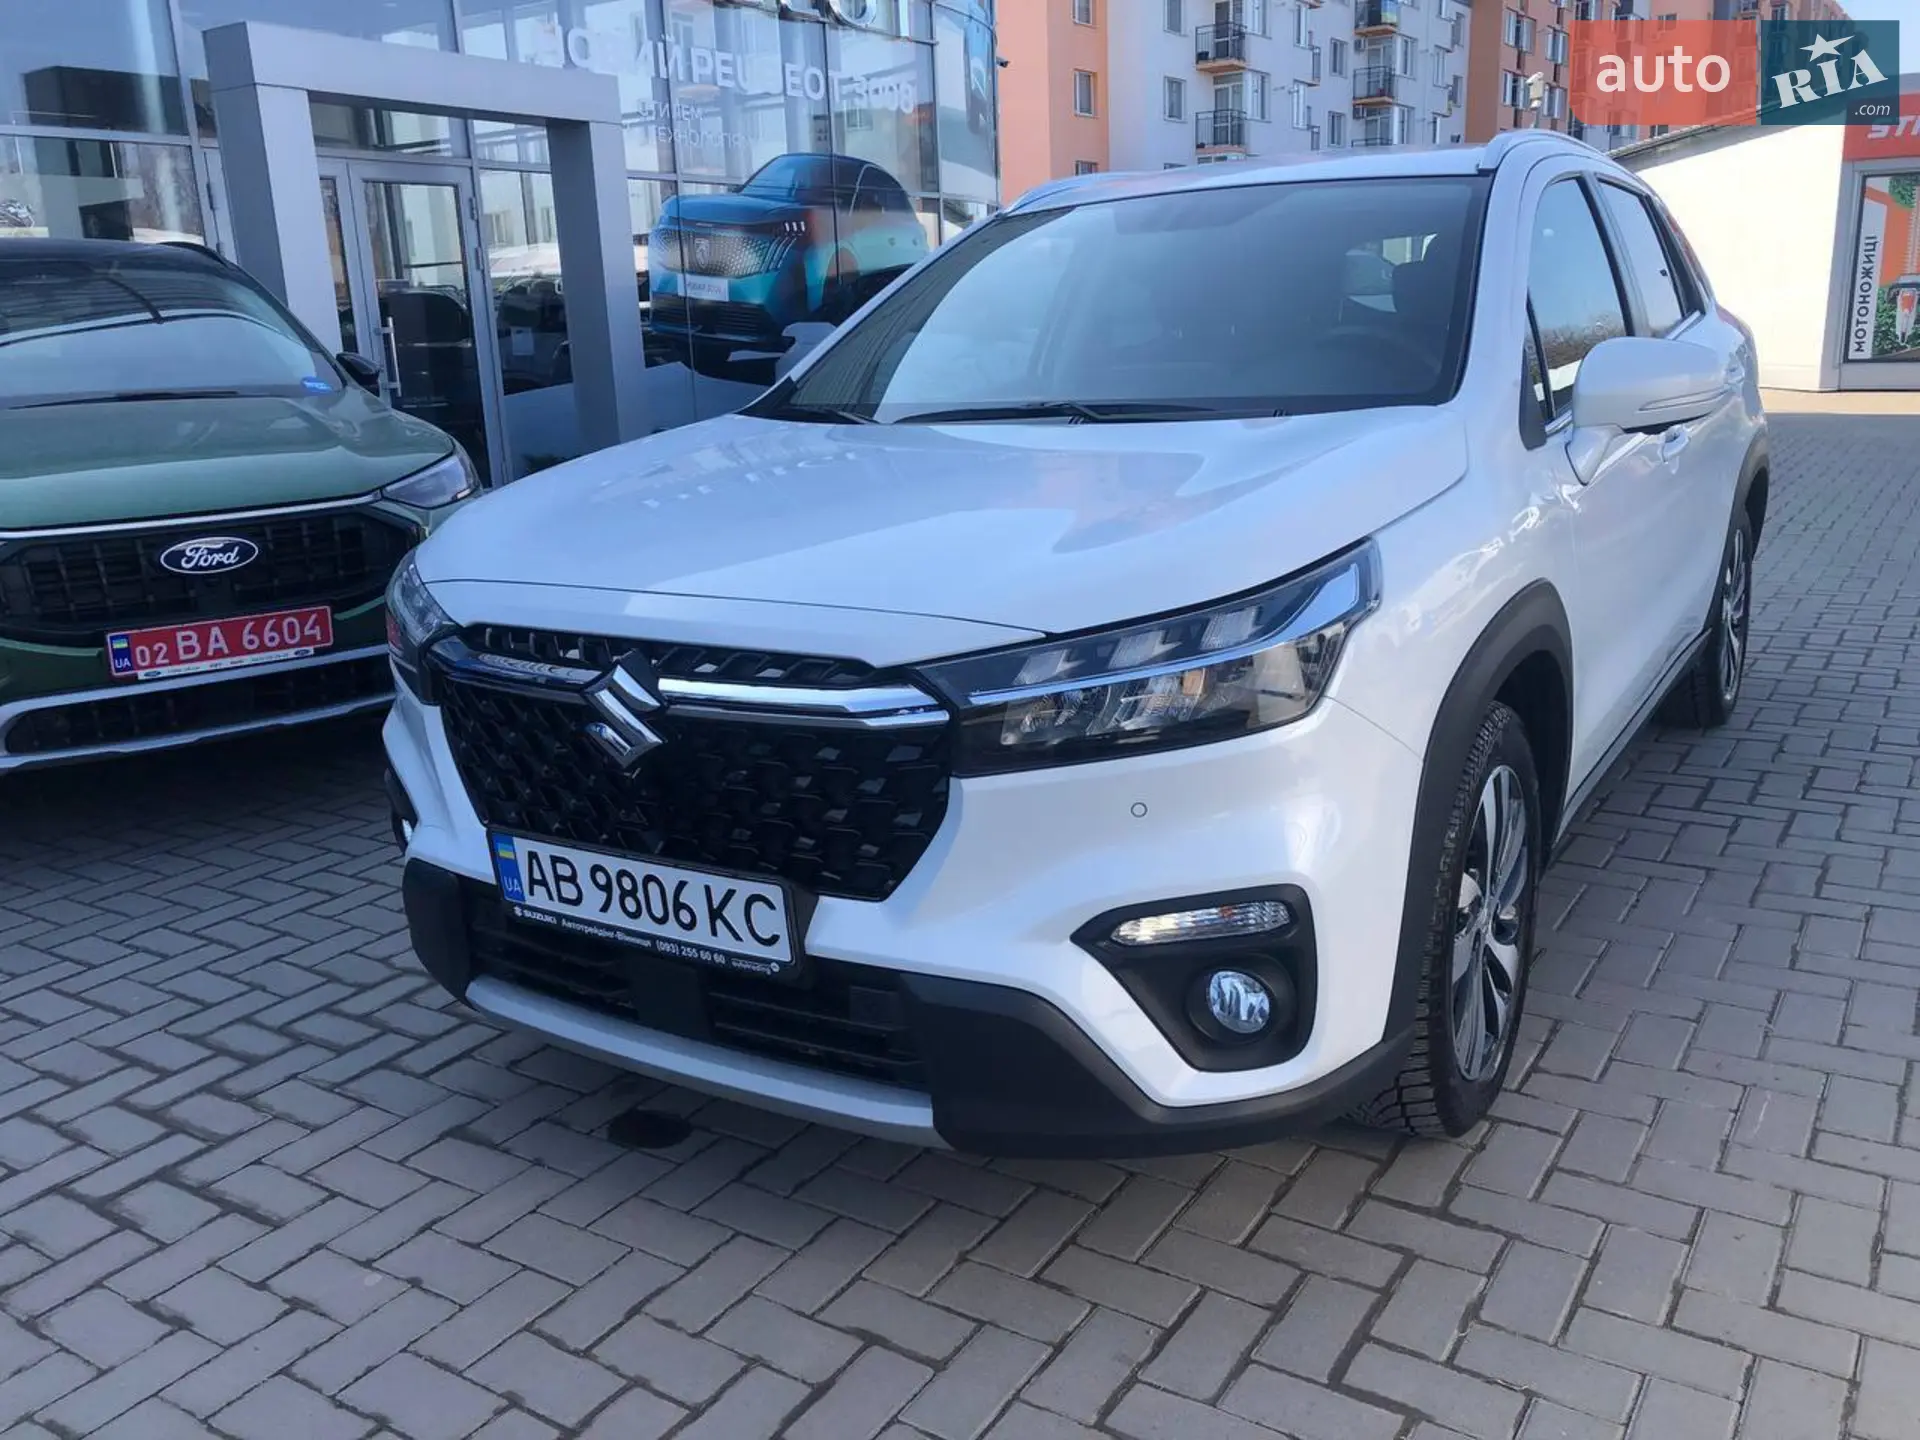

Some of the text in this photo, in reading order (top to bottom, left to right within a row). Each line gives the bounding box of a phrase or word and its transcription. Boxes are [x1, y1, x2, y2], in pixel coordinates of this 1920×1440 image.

[1854, 235, 1878, 353] МОТОНОЖИЦІ
[180, 543, 240, 569] Ford
[135, 642, 170, 668] 02
[175, 625, 230, 662] BA
[241, 613, 323, 650] 6604
[114, 658, 132, 670] UA
[503, 875, 523, 894] UA
